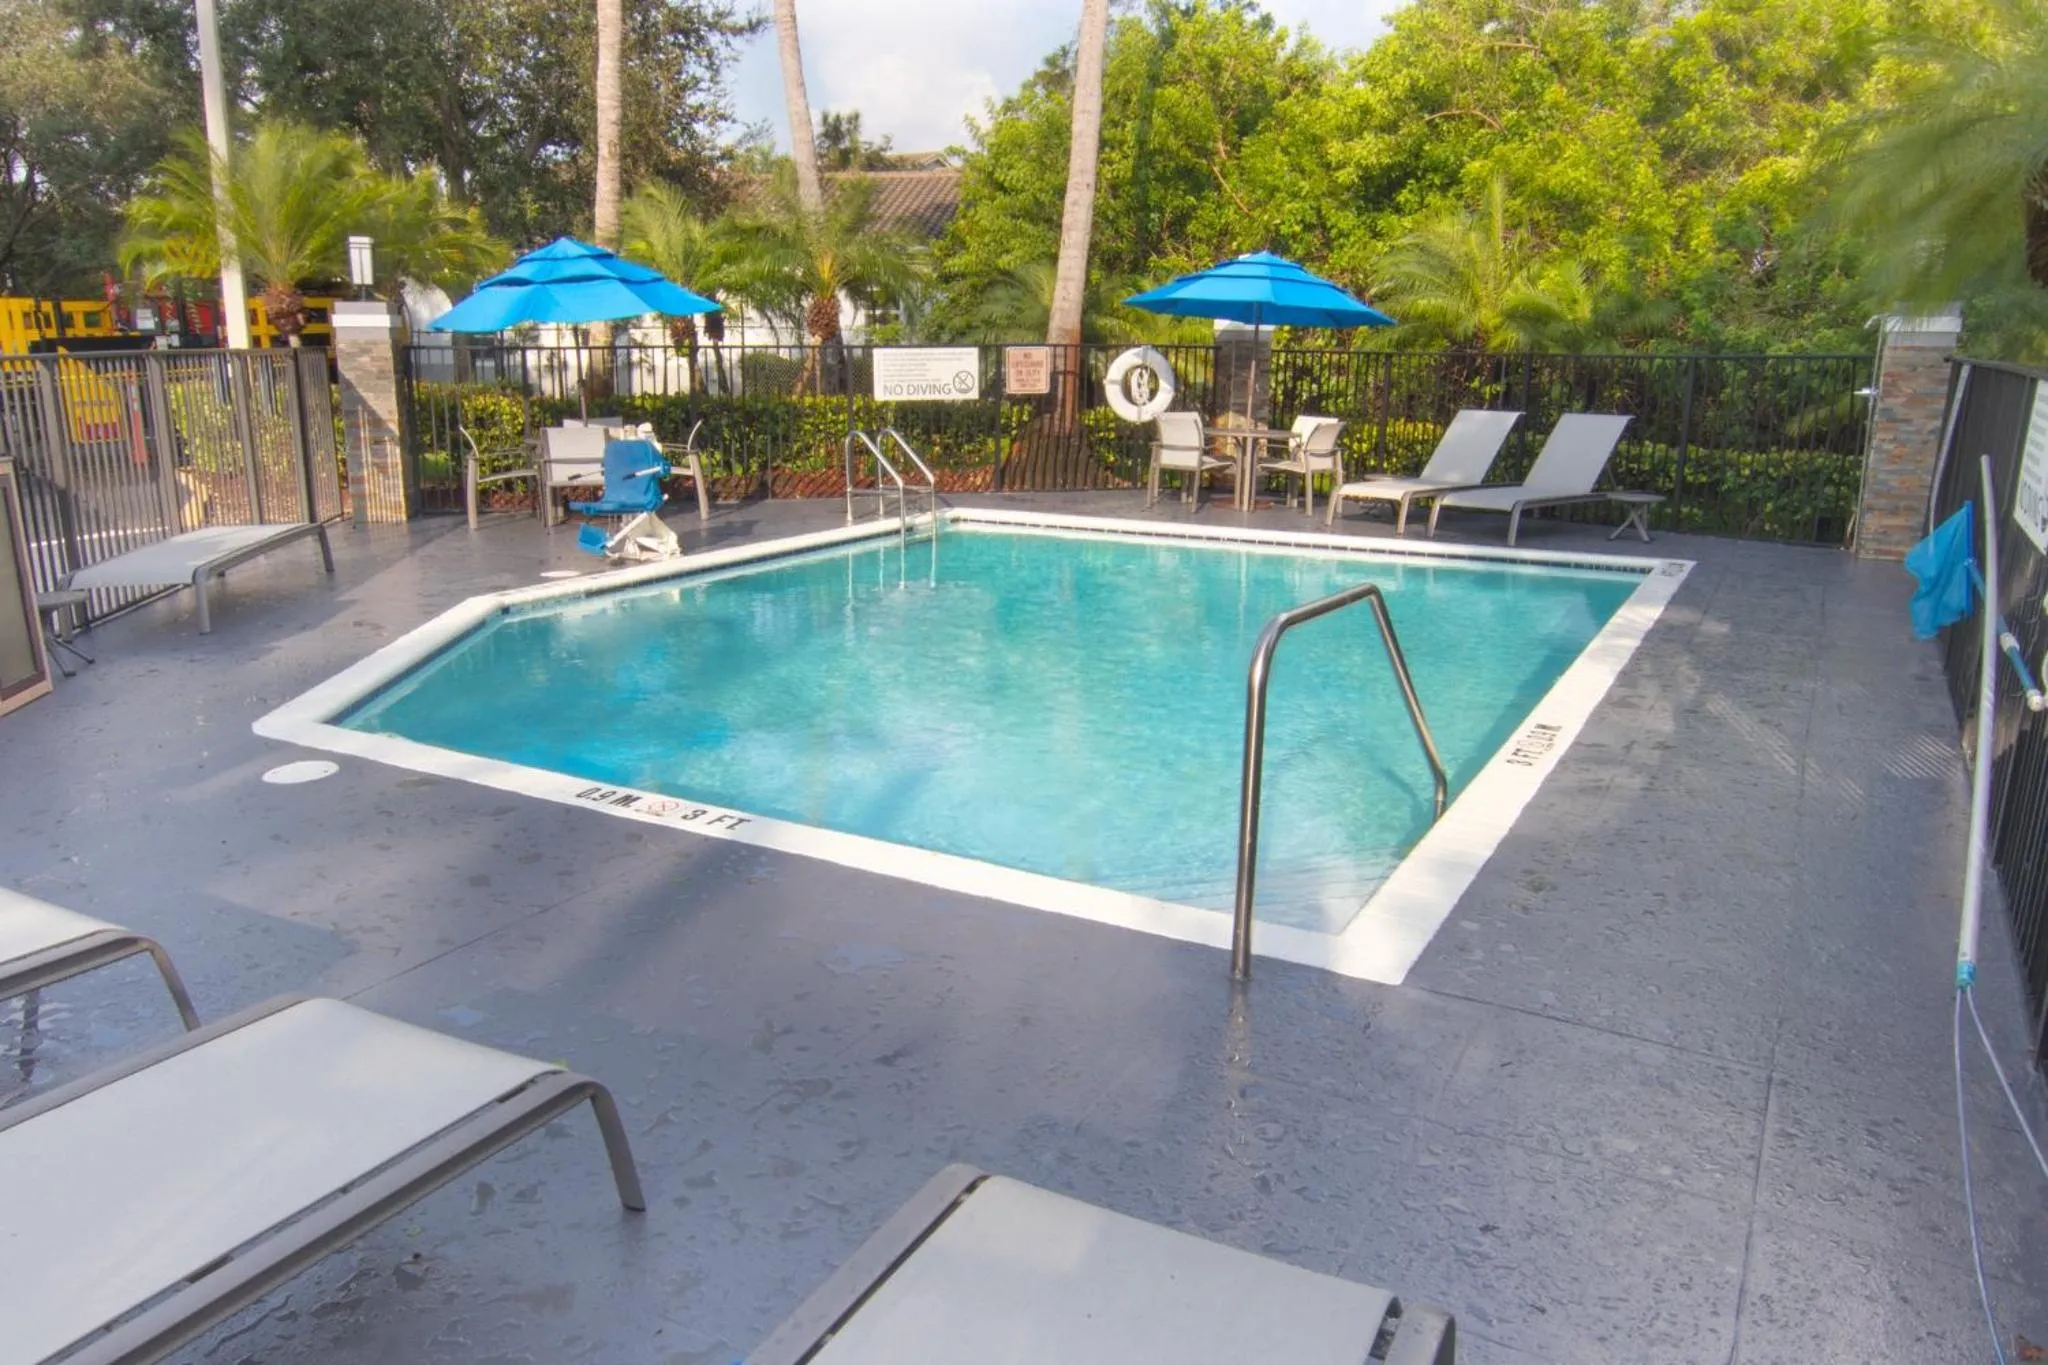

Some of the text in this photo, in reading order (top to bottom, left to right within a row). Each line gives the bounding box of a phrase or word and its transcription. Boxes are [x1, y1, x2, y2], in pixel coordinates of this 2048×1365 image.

[883, 383, 952, 396] NO DIVING
[576, 787, 617, 801] 0.9
[681, 809, 707, 821] 3
